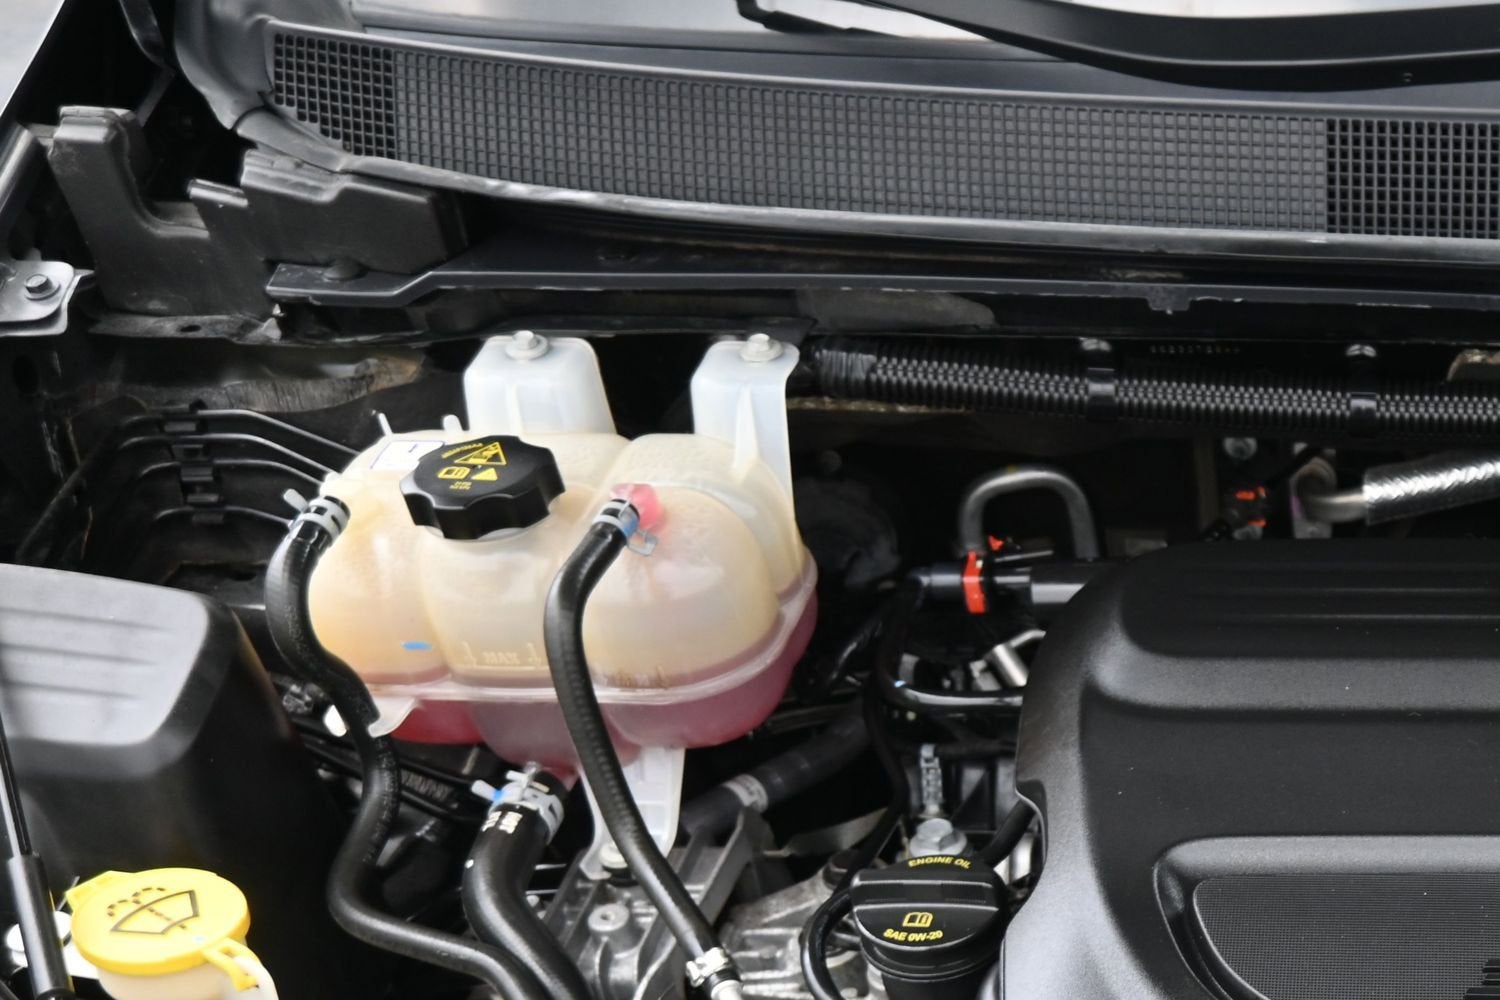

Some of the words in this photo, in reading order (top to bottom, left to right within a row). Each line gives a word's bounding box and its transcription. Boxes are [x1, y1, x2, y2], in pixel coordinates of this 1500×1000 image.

[908, 856, 953, 867] ENGINE
[954, 858, 971, 869] OIL
[883, 928, 908, 941] SAE
[908, 930, 943, 941] 0W-20
